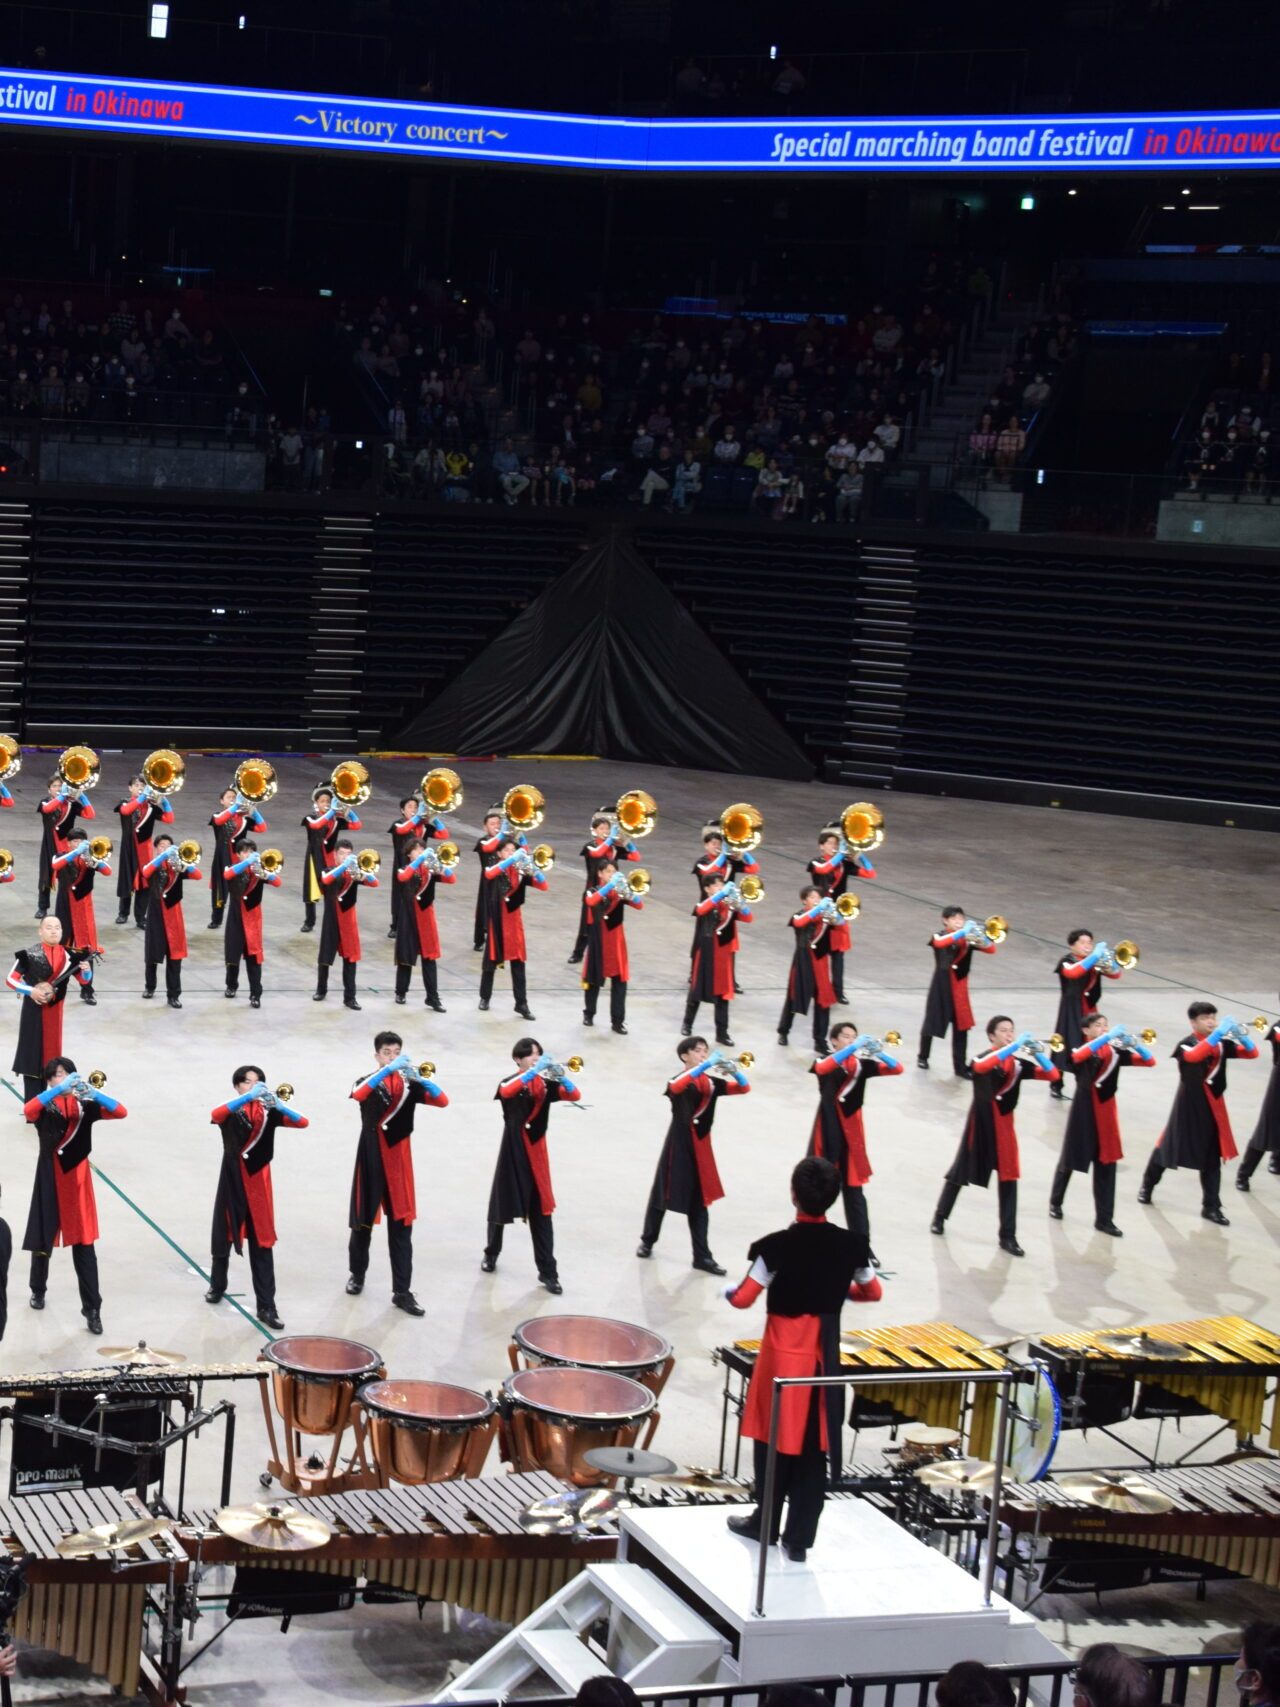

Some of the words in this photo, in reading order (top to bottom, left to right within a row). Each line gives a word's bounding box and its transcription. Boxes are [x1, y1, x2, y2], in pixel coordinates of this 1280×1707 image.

[66, 87, 86, 112] in
[92, 89, 185, 121] Okinawa
[771, 131, 852, 163] Special
[854, 130, 967, 163] marching
[971, 129, 1036, 156] band
[1038, 128, 1134, 156] festival
[1143, 129, 1169, 154] in
